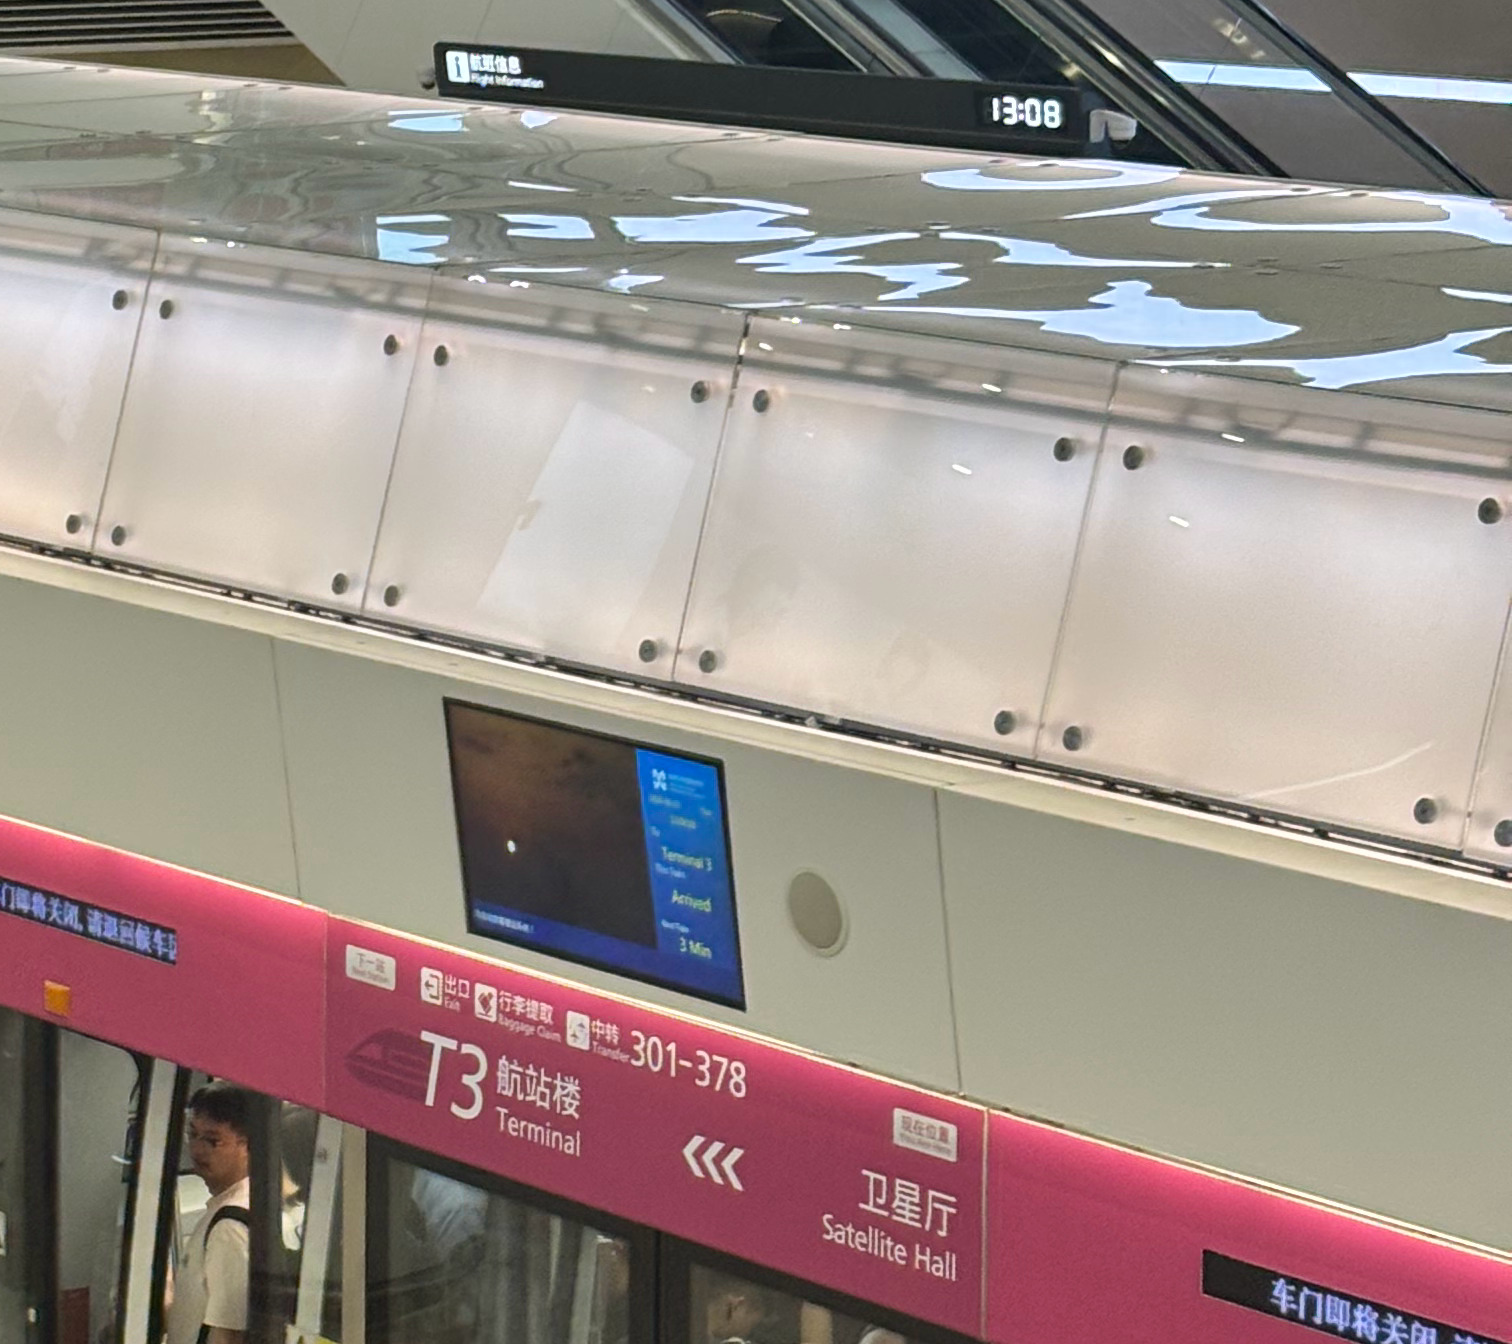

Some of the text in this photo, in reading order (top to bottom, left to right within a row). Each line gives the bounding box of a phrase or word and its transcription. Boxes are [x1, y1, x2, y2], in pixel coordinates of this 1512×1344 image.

[991, 96, 1062, 129] 13:08
[444, 975, 470, 999] 出口
[499, 991, 553, 1026] 行李提取
[591, 1019, 620, 1046] 中转
[537, 1024, 562, 1043] Claim
[592, 1041, 631, 1063] Transfer
[420, 1030, 488, 1120] T3
[496, 1055, 581, 1119] 航站楼
[630, 1030, 747, 1099] 301-378
[495, 1106, 581, 1157] Terminal
[859, 1168, 957, 1237] 卫星厅
[822, 1213, 957, 1282] Satellite Hall
